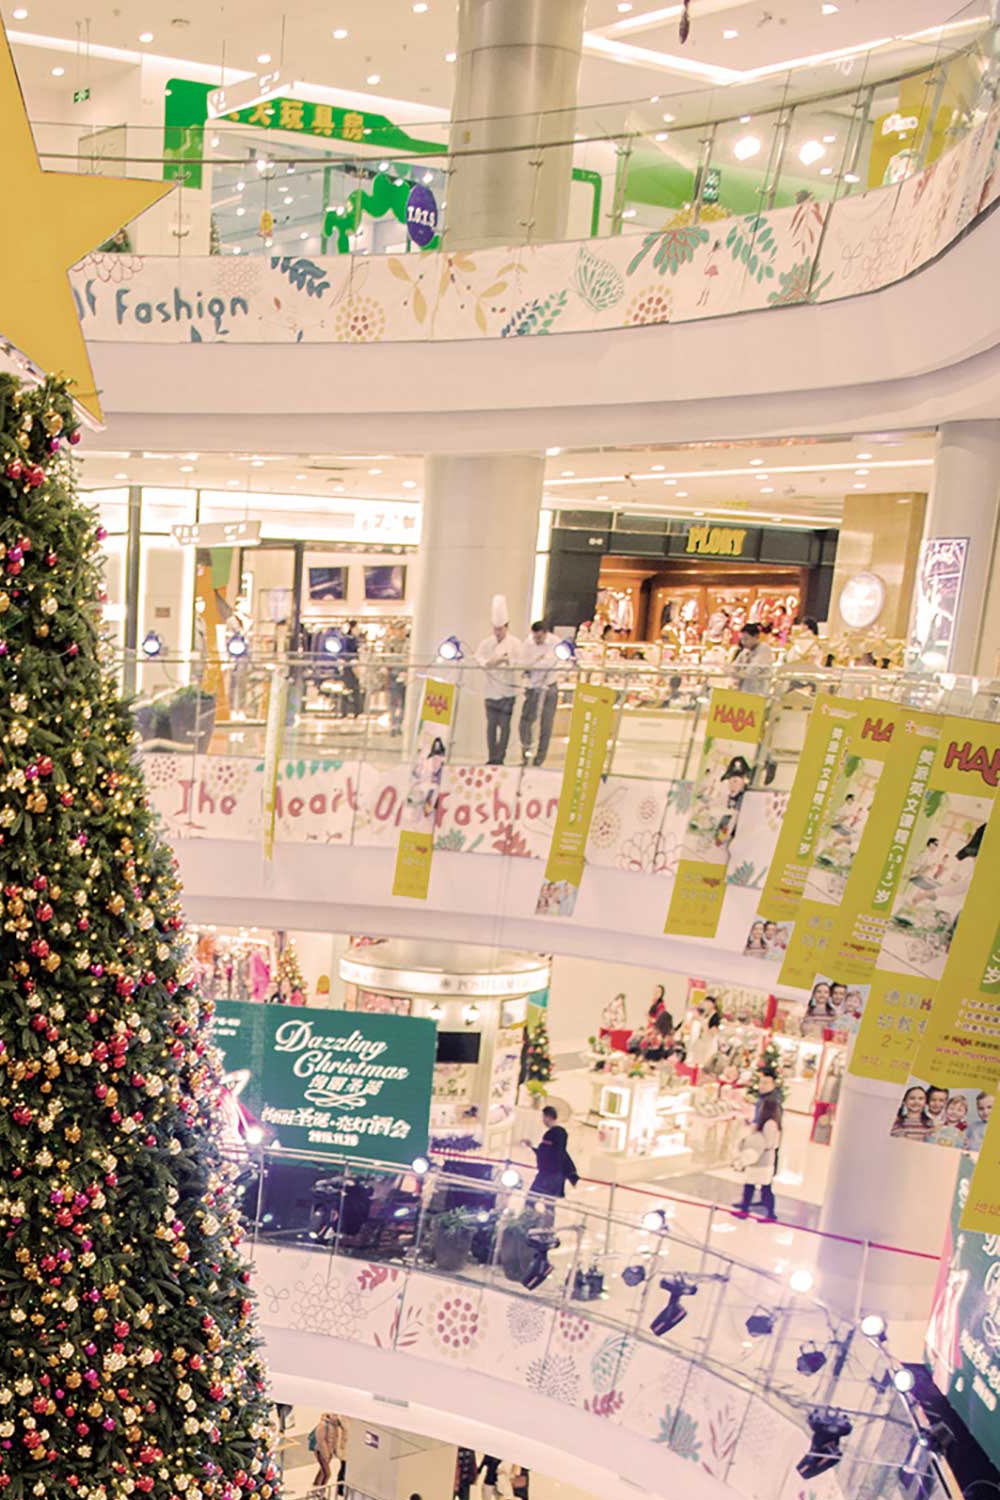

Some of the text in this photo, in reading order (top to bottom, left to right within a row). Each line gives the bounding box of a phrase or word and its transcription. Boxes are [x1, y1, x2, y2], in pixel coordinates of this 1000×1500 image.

[114, 287, 249, 325] Fashion
[713, 704, 756, 732] HABA
[176, 779, 238, 817] The
[274, 1019, 388, 1060] Dazzling
[293, 1049, 409, 1081] Christmas
